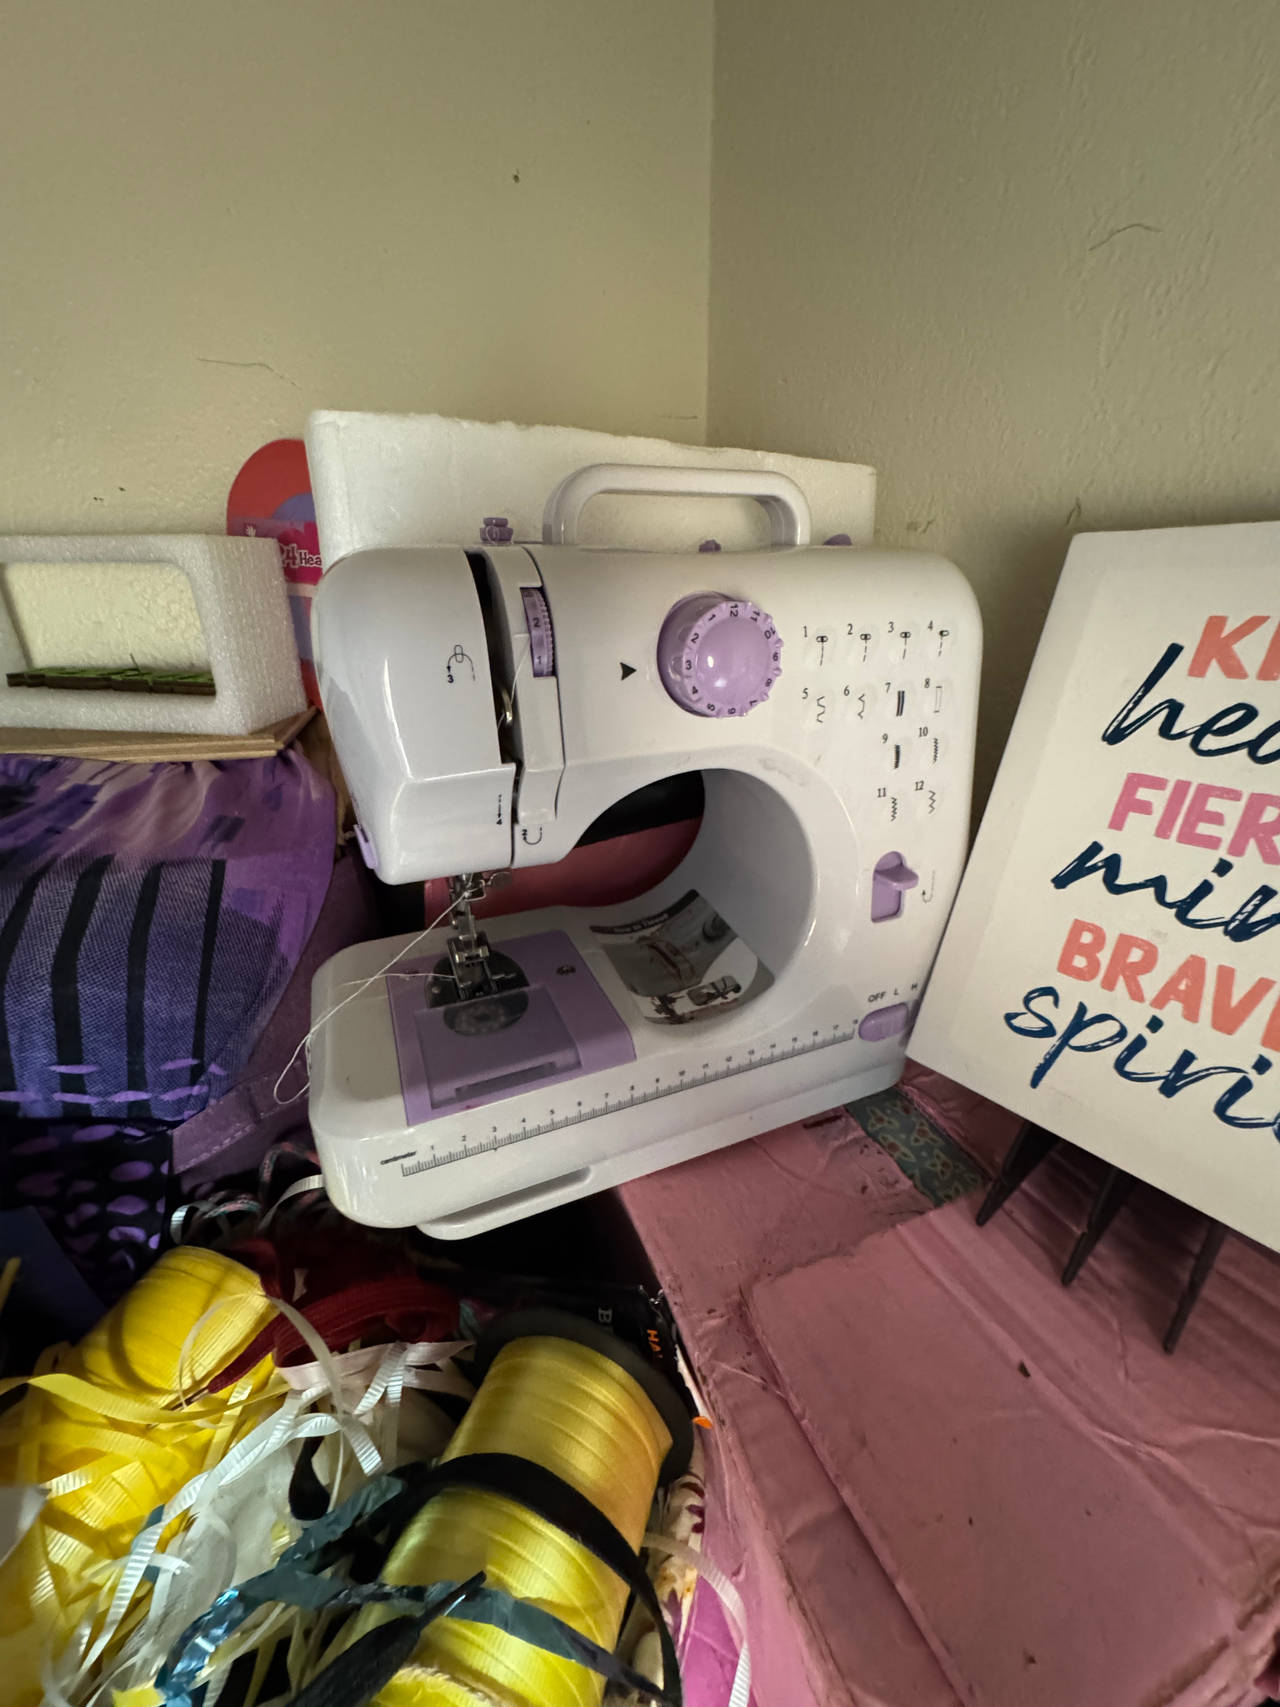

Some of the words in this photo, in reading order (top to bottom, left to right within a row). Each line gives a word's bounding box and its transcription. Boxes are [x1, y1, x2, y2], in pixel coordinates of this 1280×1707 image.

[707, 613, 717, 622] 1
[729, 603, 739, 618] 12
[532, 616, 542, 628] 2
[802, 625, 809, 638] 1
[847, 623, 854, 636] 2
[887, 621, 895, 633] 3
[927, 620, 934, 631] 4
[690, 632, 700, 644] 2
[536, 655, 542, 665] 1
[685, 659, 692, 671] 3
[447, 674, 455, 684] 3
[691, 685, 699, 695] 4
[802, 687, 809, 700] 5
[843, 684, 850, 697] 6
[885, 681, 891, 693] 7
[923, 677, 931, 689] 8
[882, 733, 888, 744] 9
[918, 726, 929, 738] 10
[877, 787, 887, 798] 11
[915, 781, 925, 791] 12
[1107, 772, 1280, 866] FIER
[868, 991, 886, 1003] OFF
[893, 987, 899, 996] L
[1004, 986, 1280, 1144] spiri
